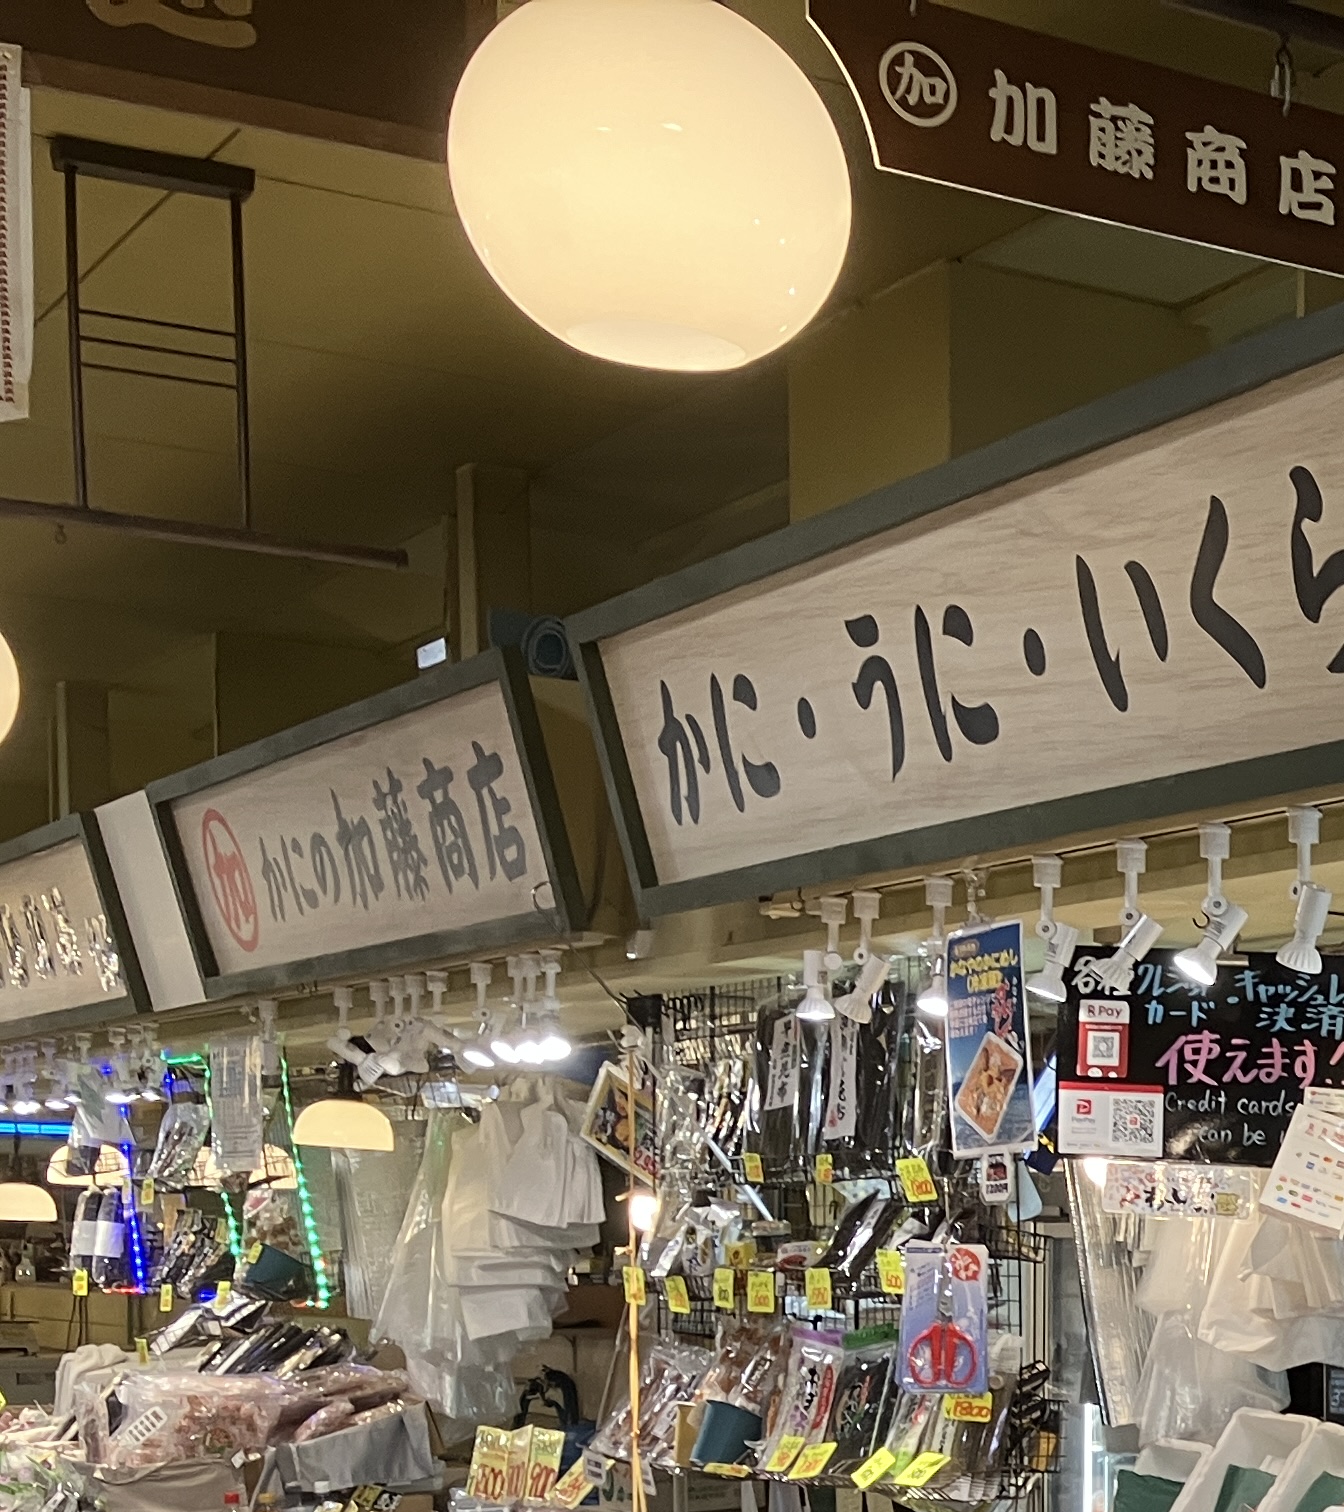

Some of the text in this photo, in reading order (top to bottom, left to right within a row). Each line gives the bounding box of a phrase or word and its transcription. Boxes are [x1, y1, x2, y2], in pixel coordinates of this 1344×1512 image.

[989, 67, 1336, 226] 加藤商店
[260, 740, 528, 923] かにの加藤商店
[1145, 999, 1216, 1028] カード
[1165, 1090, 1295, 1117] Credit cards
[1199, 1123, 1267, 1146] can be
